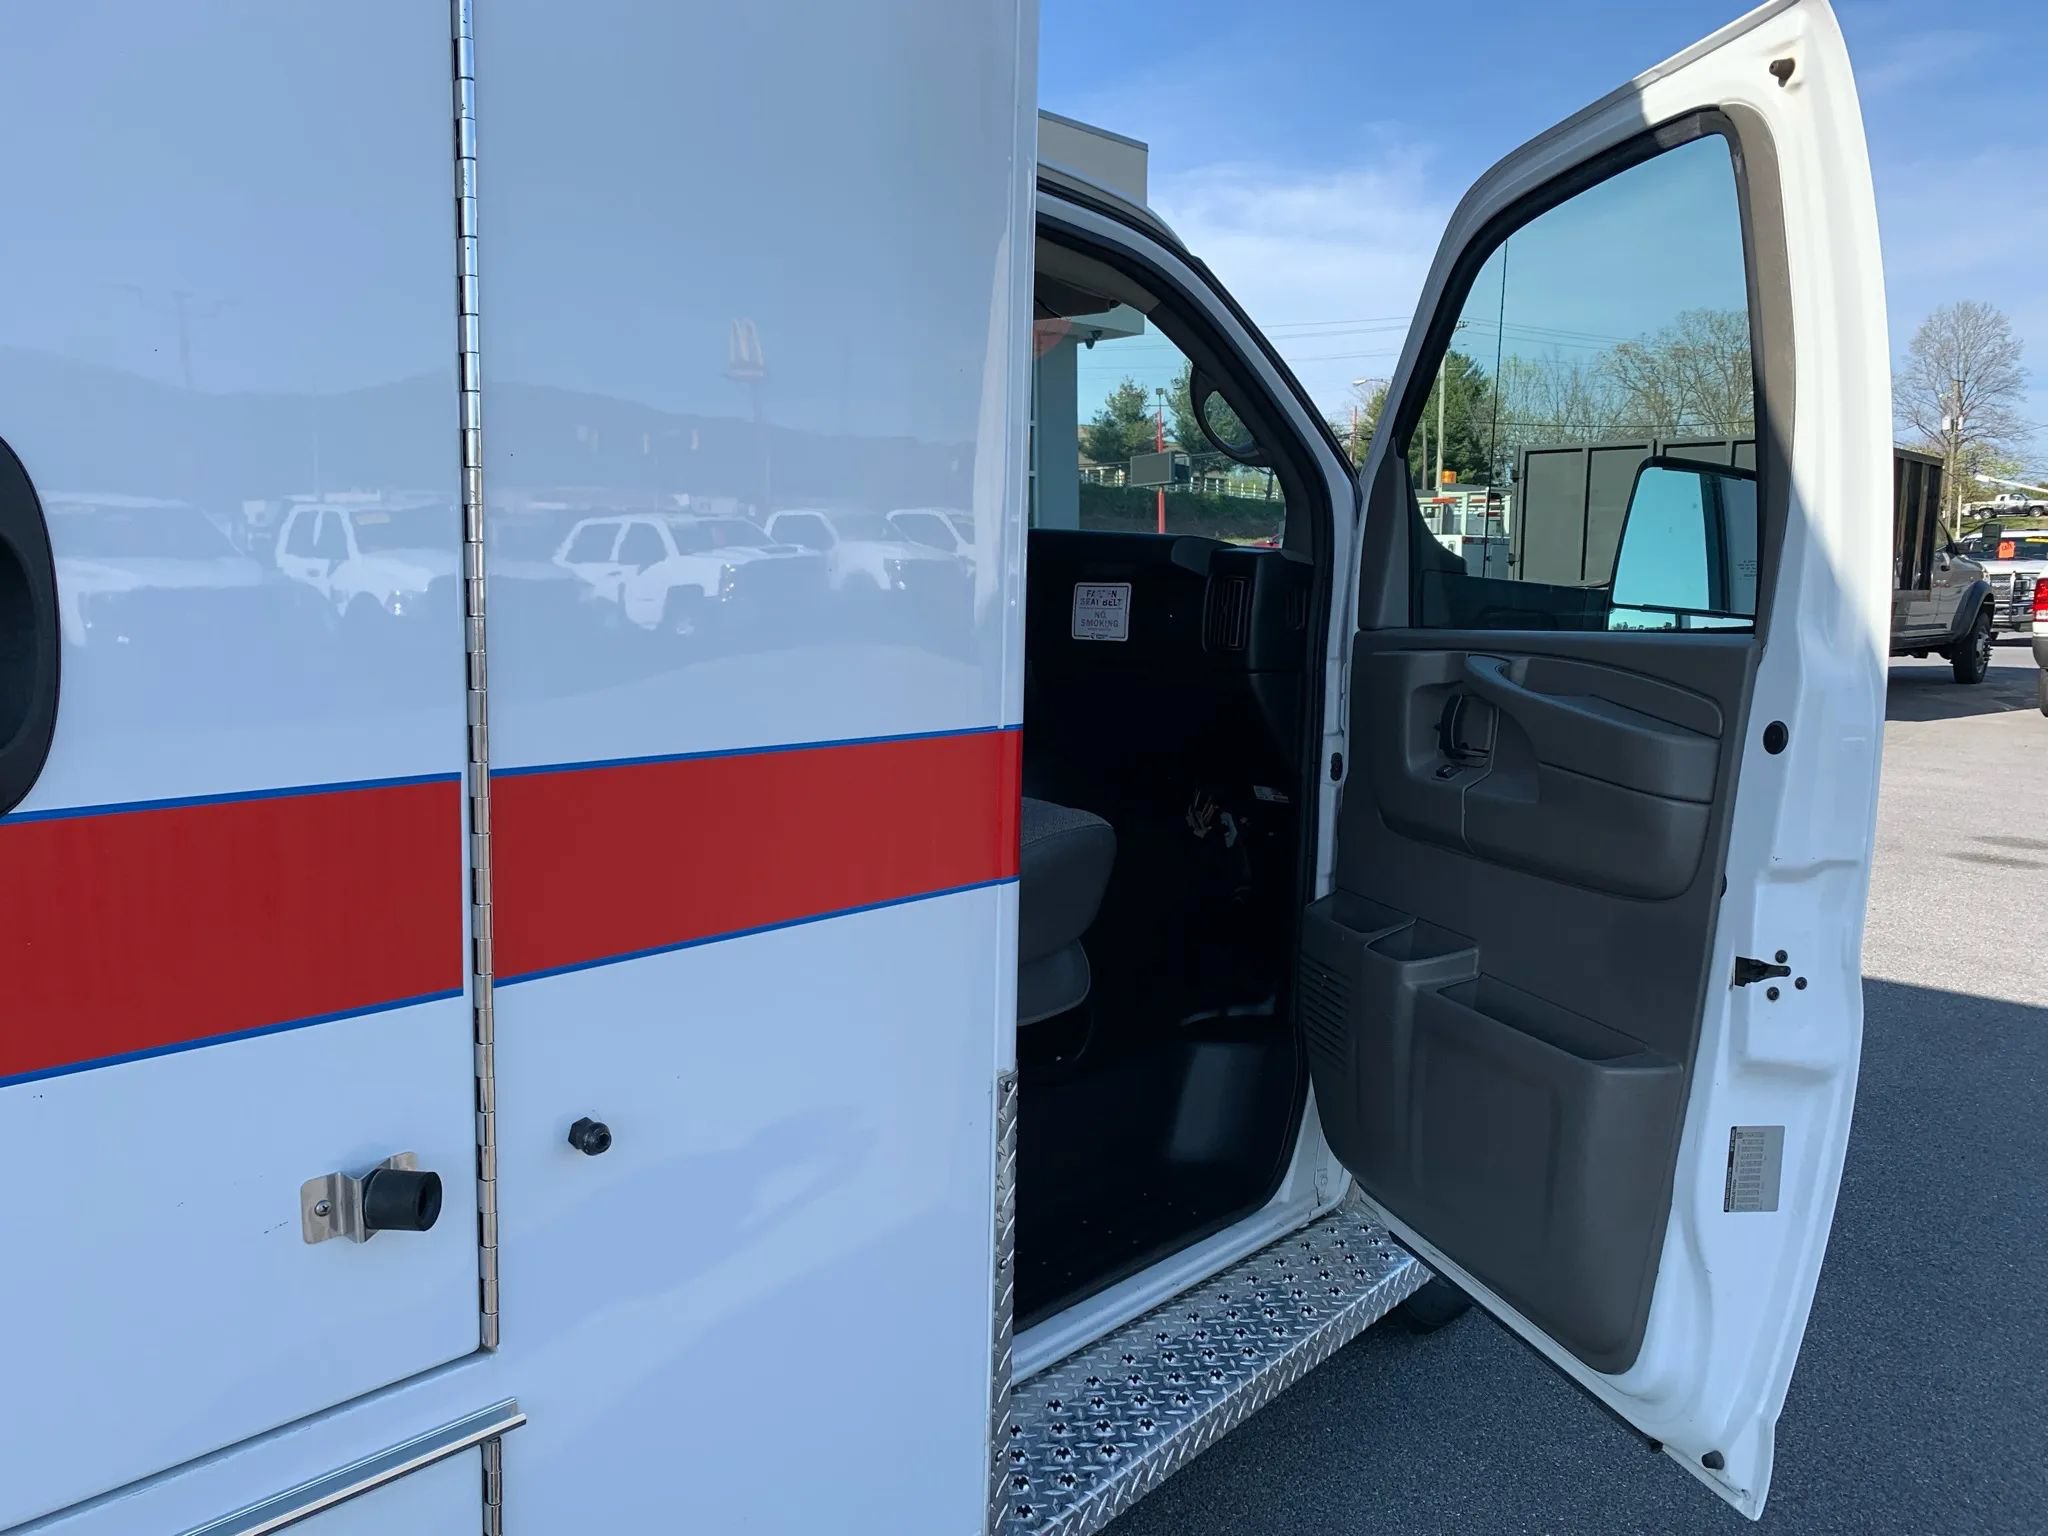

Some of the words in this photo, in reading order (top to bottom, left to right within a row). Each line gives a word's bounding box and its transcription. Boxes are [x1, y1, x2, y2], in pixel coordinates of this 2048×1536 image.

[1087, 590, 1118, 598] FATN
[1102, 599, 1122, 607] BELT
[1080, 619, 1119, 628] SMOKING
